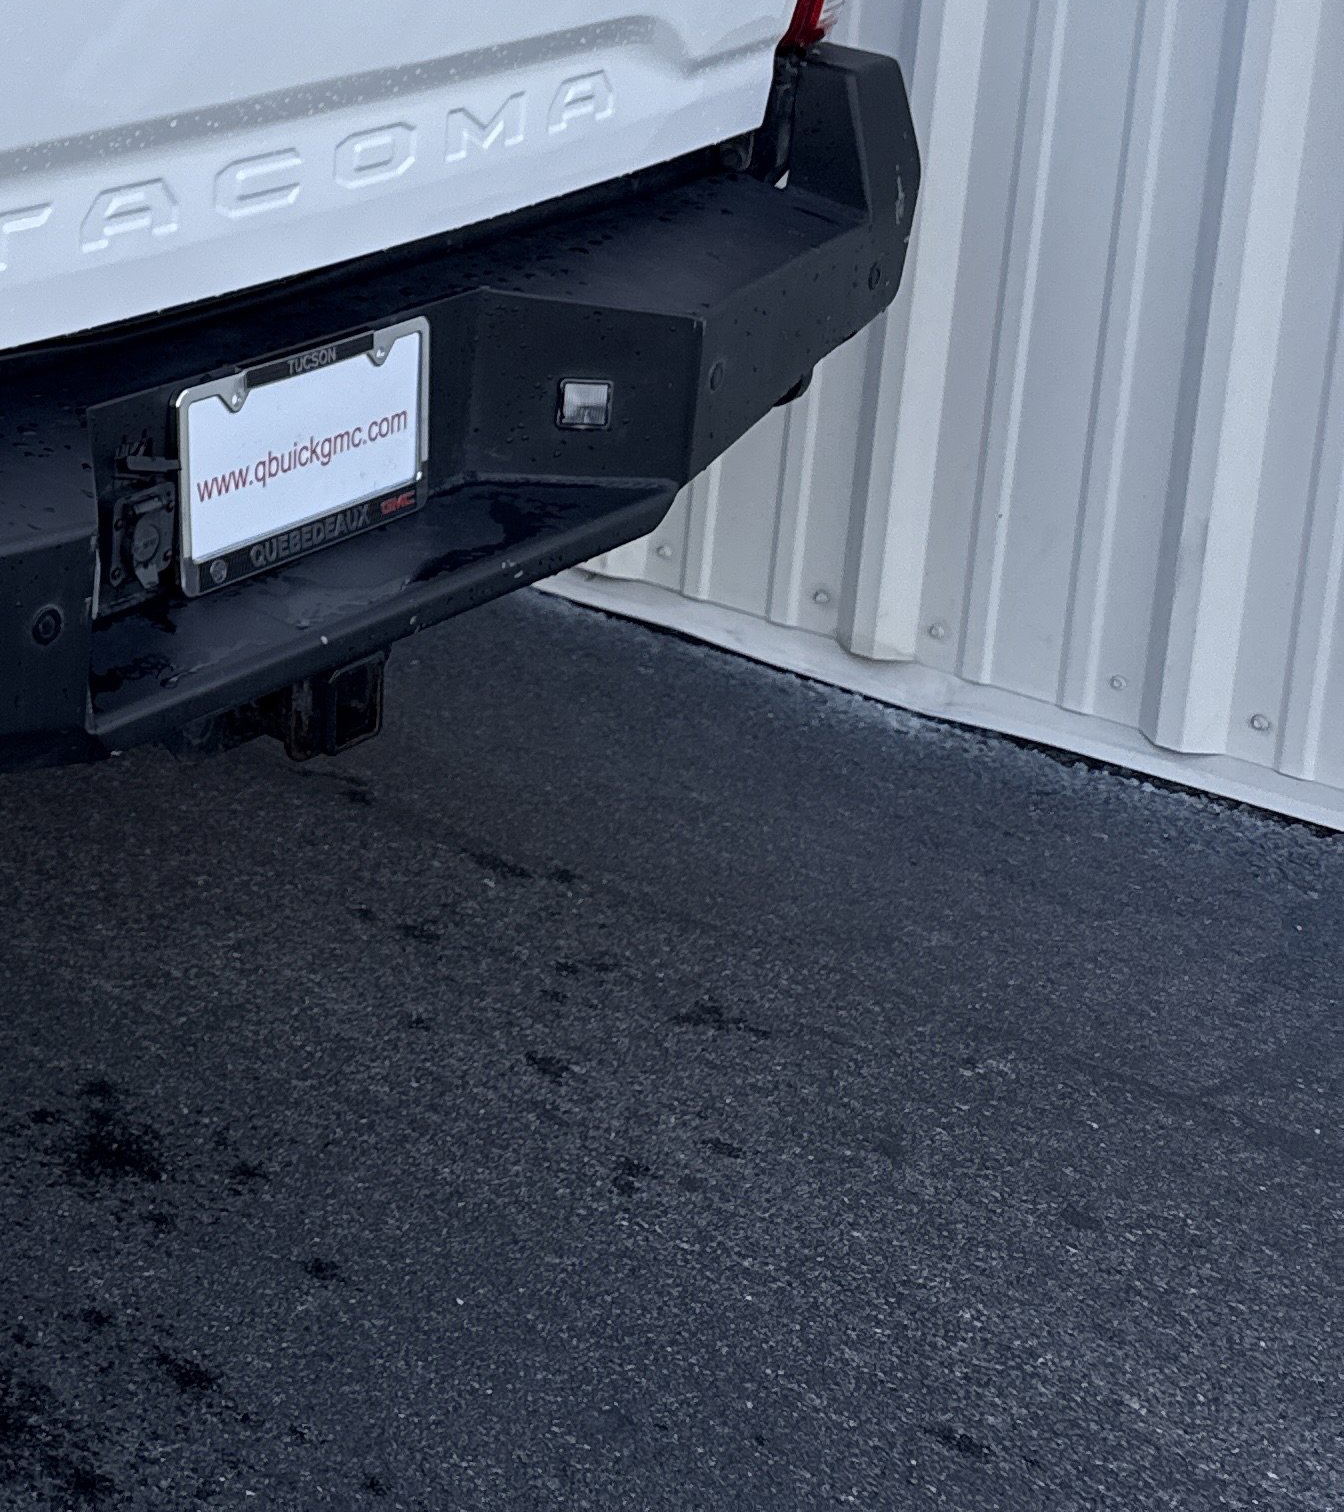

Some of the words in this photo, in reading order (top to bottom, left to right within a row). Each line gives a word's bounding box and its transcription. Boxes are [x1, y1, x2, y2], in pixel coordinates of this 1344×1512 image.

[287, 347, 336, 375] TUCSON
[197, 408, 408, 502] www.qbuickgmc.com
[381, 490, 415, 515] GMC
[250, 504, 371, 568] QUEBEDEAUX
